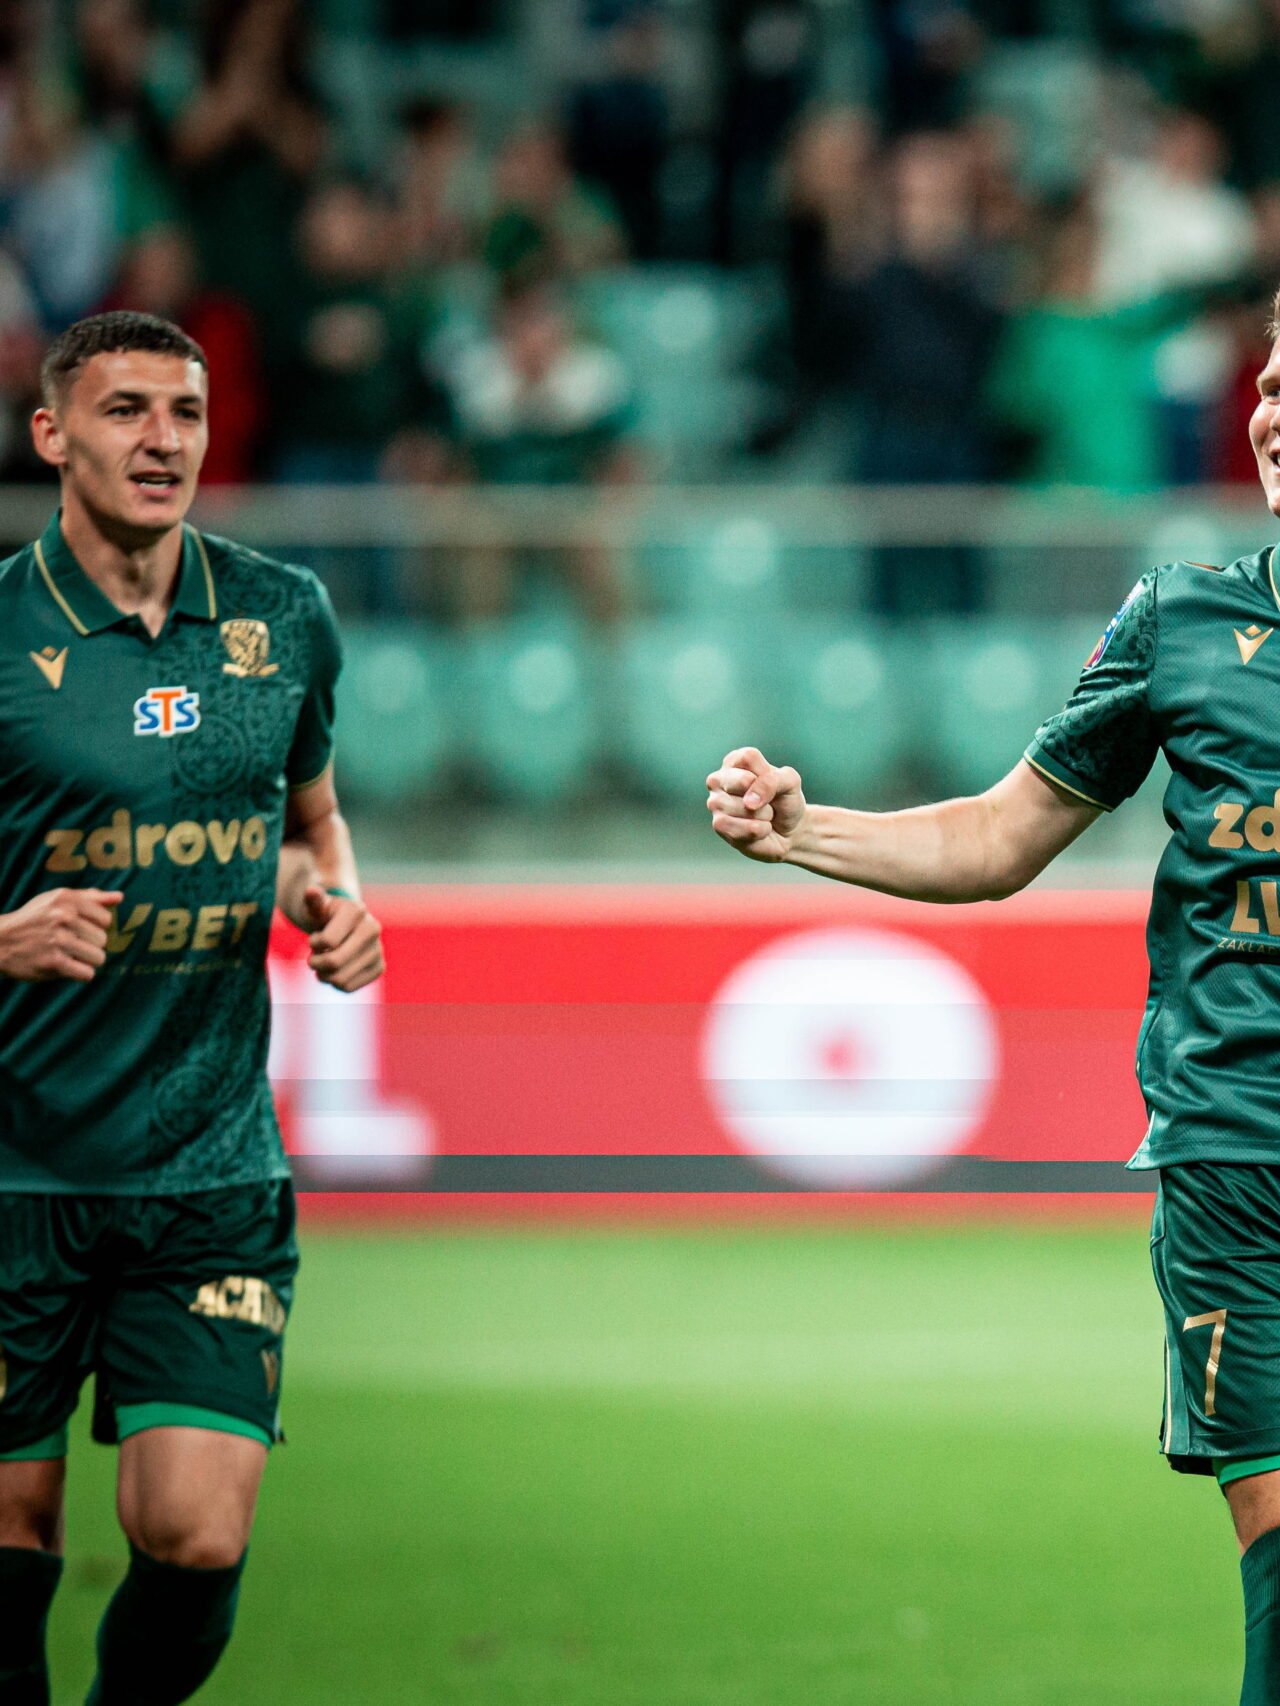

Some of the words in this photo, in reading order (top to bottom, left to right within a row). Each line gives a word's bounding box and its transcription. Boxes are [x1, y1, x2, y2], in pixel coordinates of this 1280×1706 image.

[135, 687, 199, 737] STS
[44, 808, 266, 872] zdrovo
[106, 901, 259, 953] VBET
[1182, 1309, 1227, 1416] 7
